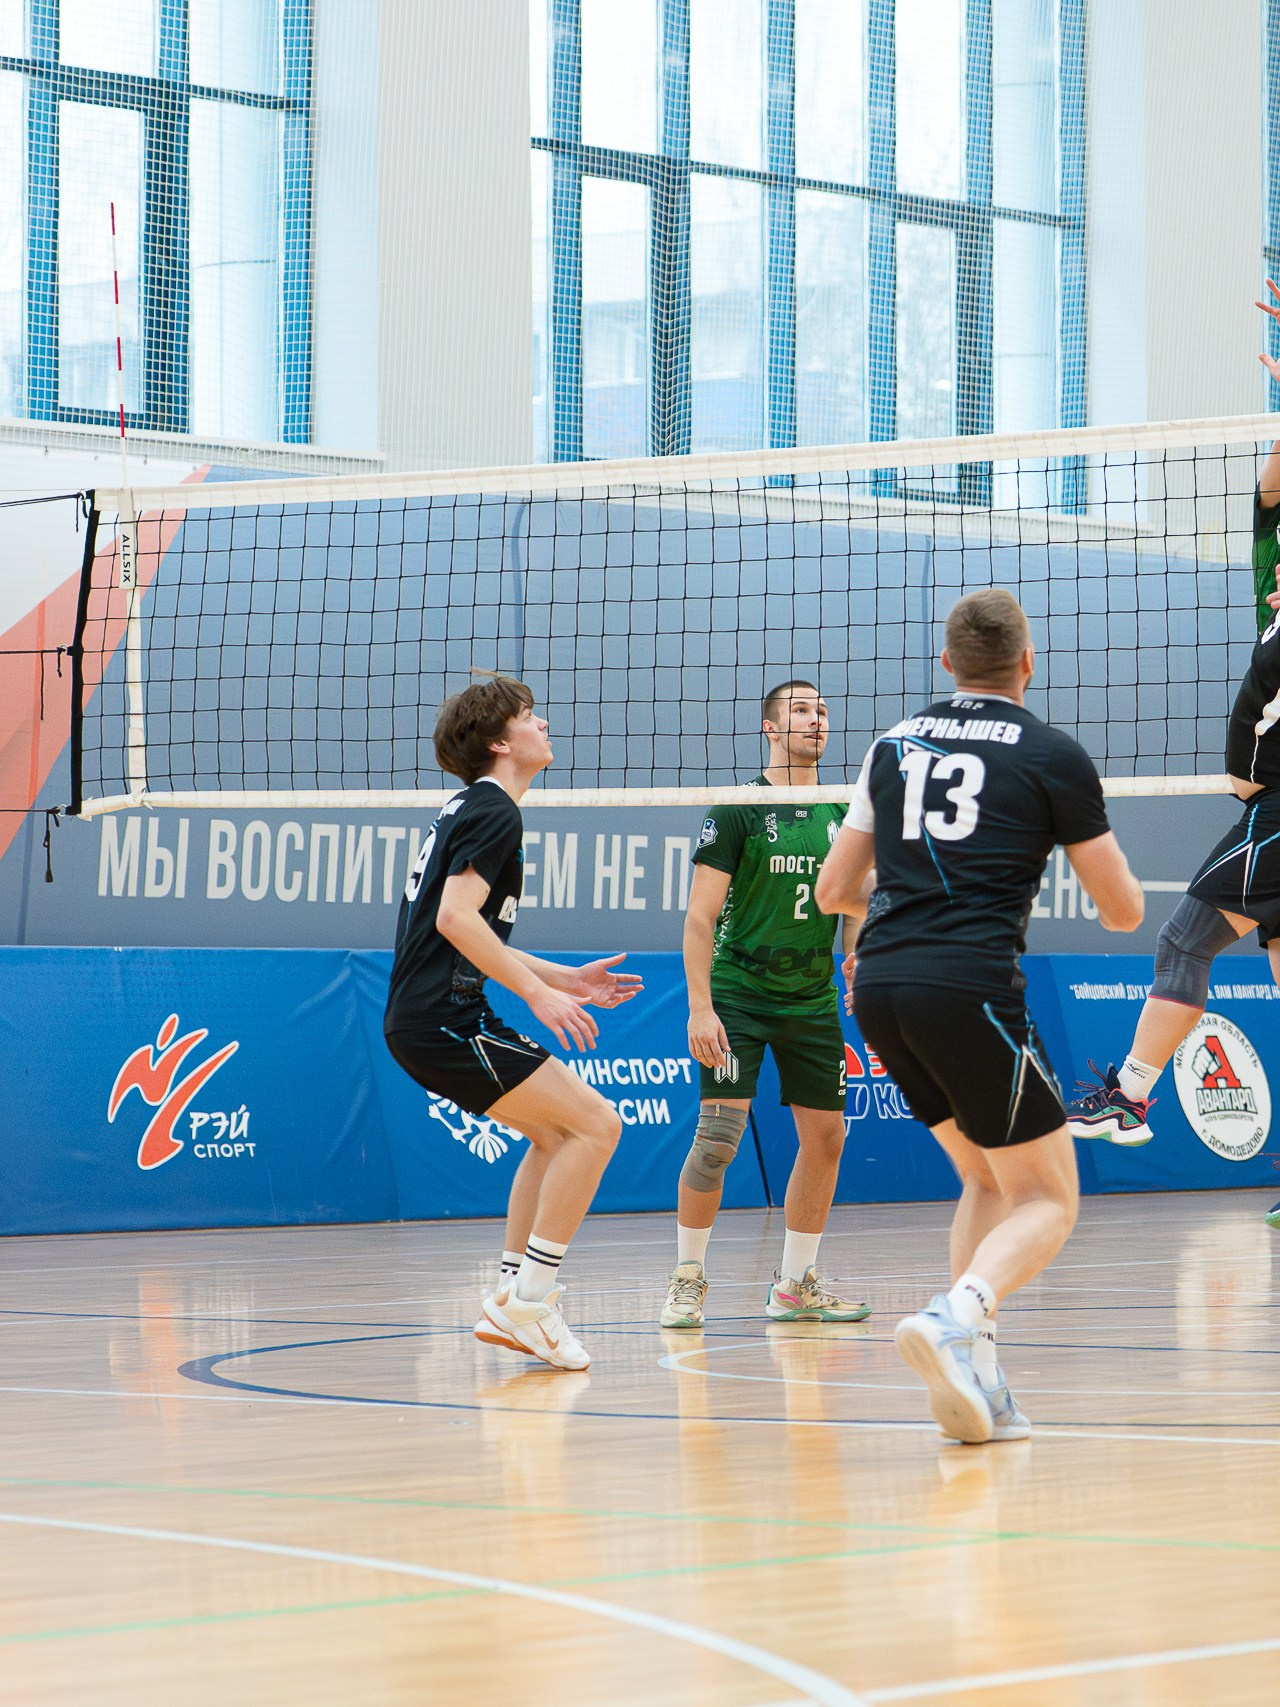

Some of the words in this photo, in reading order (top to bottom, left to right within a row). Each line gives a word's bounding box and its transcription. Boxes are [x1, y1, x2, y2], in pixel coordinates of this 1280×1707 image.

[122, 534, 131, 583] ALLSIX
[898, 750, 986, 841] 13
[98, 815, 190, 899] МЫ
[593, 833, 649, 910] НЕ
[769, 855, 825, 875] МОСТ-
[793, 883, 810, 920] 2
[1221, 1021, 1259, 1068] ОБЛАСТЬ
[1196, 1087, 1259, 1115] АВАНГАРД
[189, 1104, 250, 1140] РЭЙ
[193, 1142, 256, 1158] СПОРТ
[1208, 1126, 1265, 1158] ДОМОДЕДОВО
